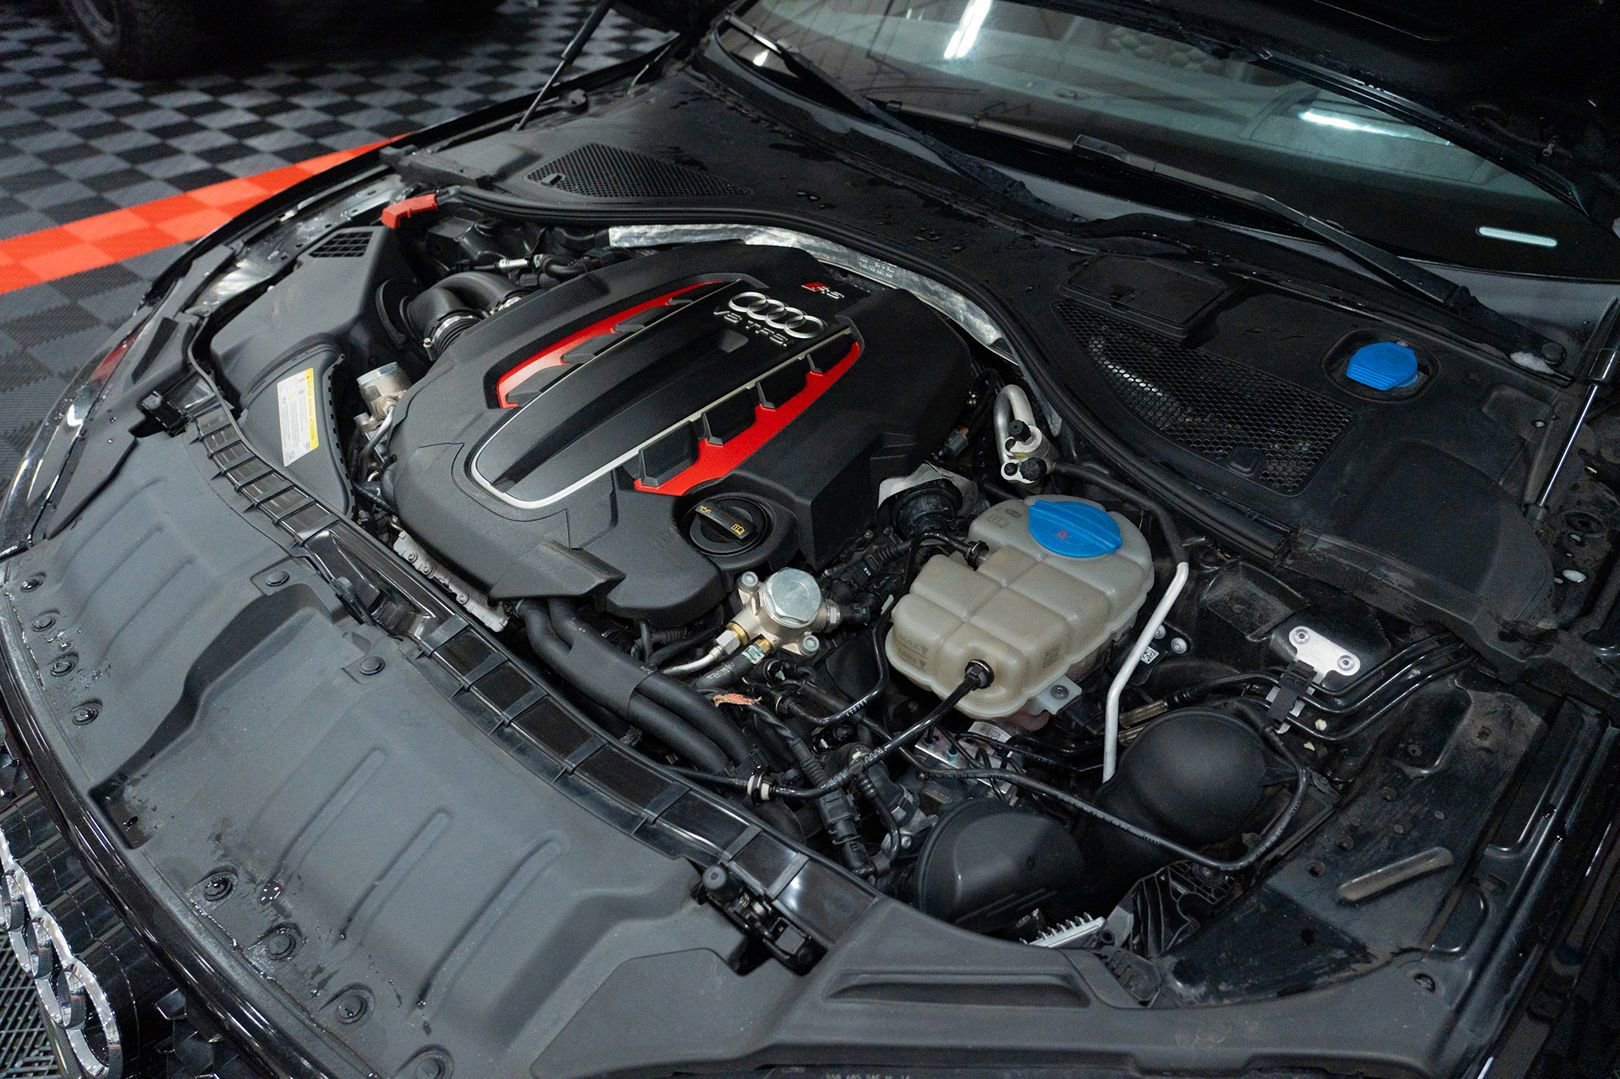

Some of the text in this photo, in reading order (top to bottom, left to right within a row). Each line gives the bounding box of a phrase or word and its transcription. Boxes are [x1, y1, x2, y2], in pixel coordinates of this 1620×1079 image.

[813, 285, 845, 299] RS
[714, 308, 788, 347] V8 TFSI
